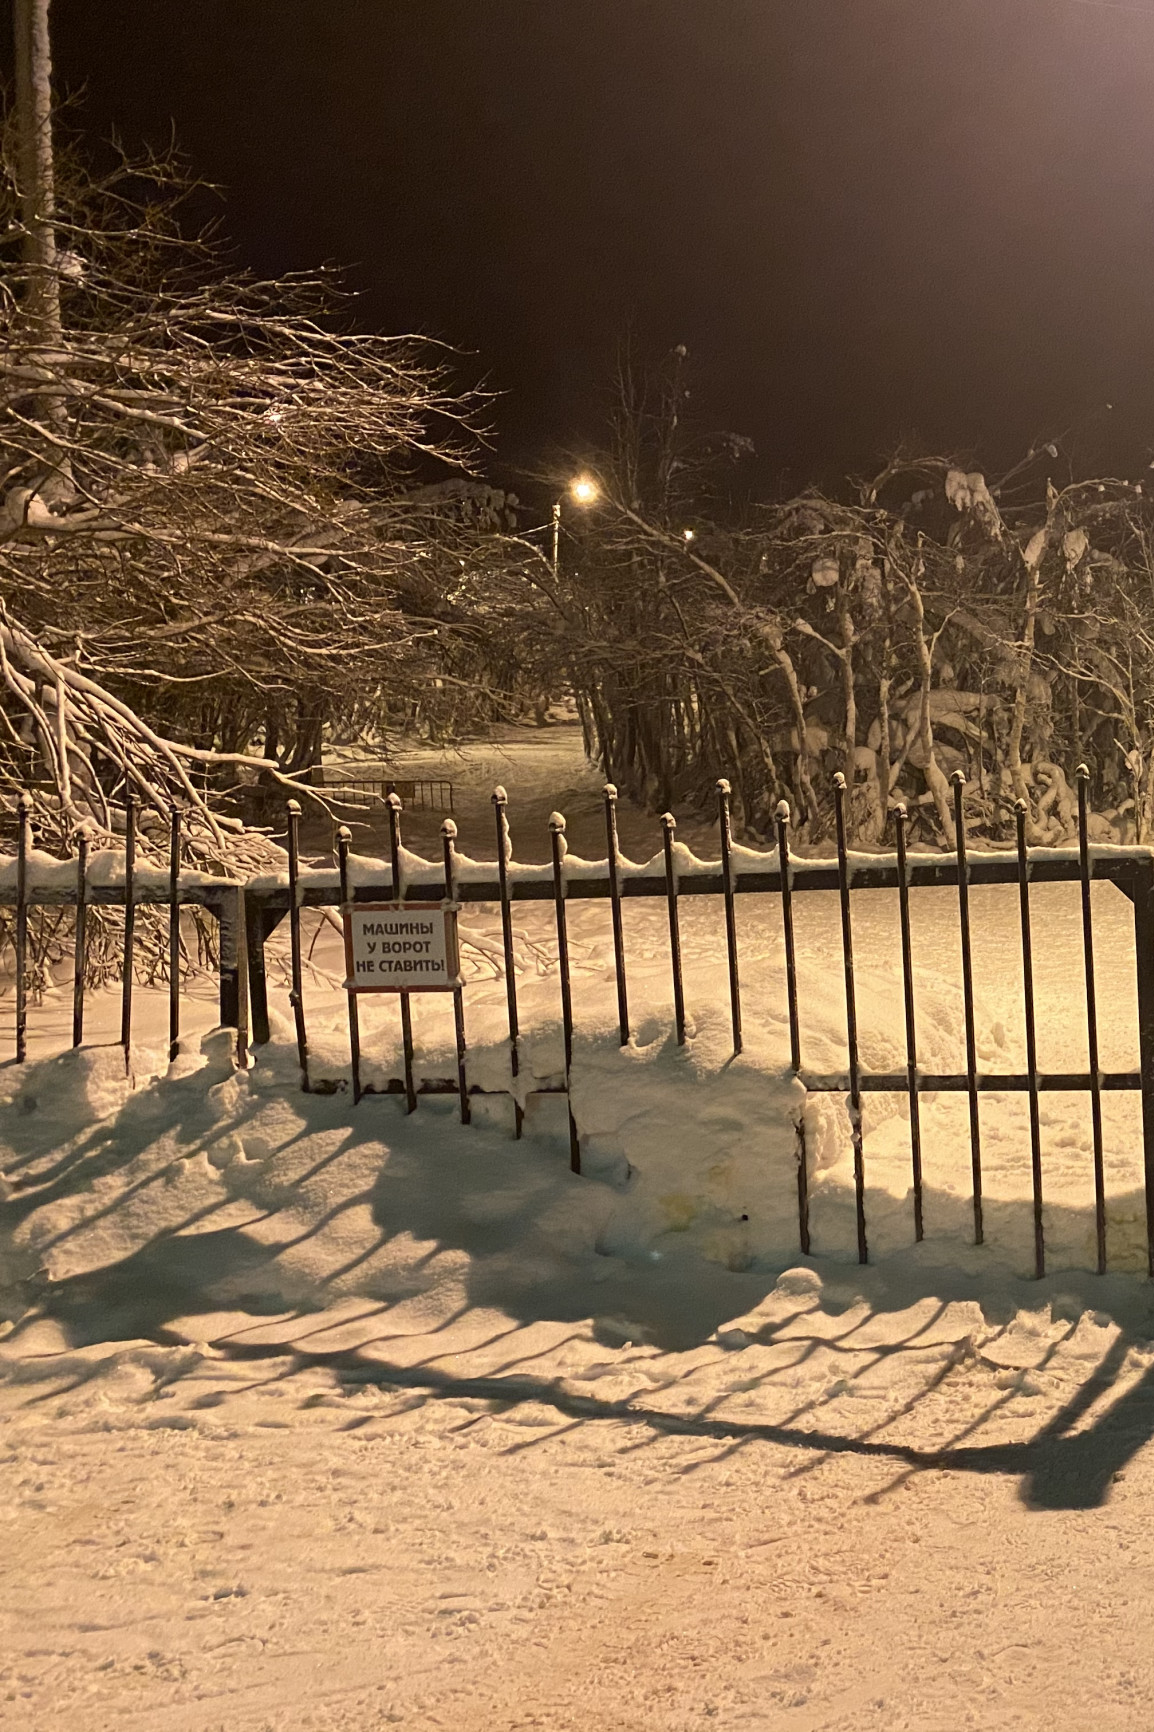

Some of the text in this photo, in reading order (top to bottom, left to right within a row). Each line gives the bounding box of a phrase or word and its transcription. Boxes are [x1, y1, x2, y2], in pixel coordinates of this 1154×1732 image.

[362, 922, 434, 935] МАШИНЫ
[367, 941, 430, 954] У ВОРОТ
[356, 959, 445, 972] НЕ СТАВИТЬ!
